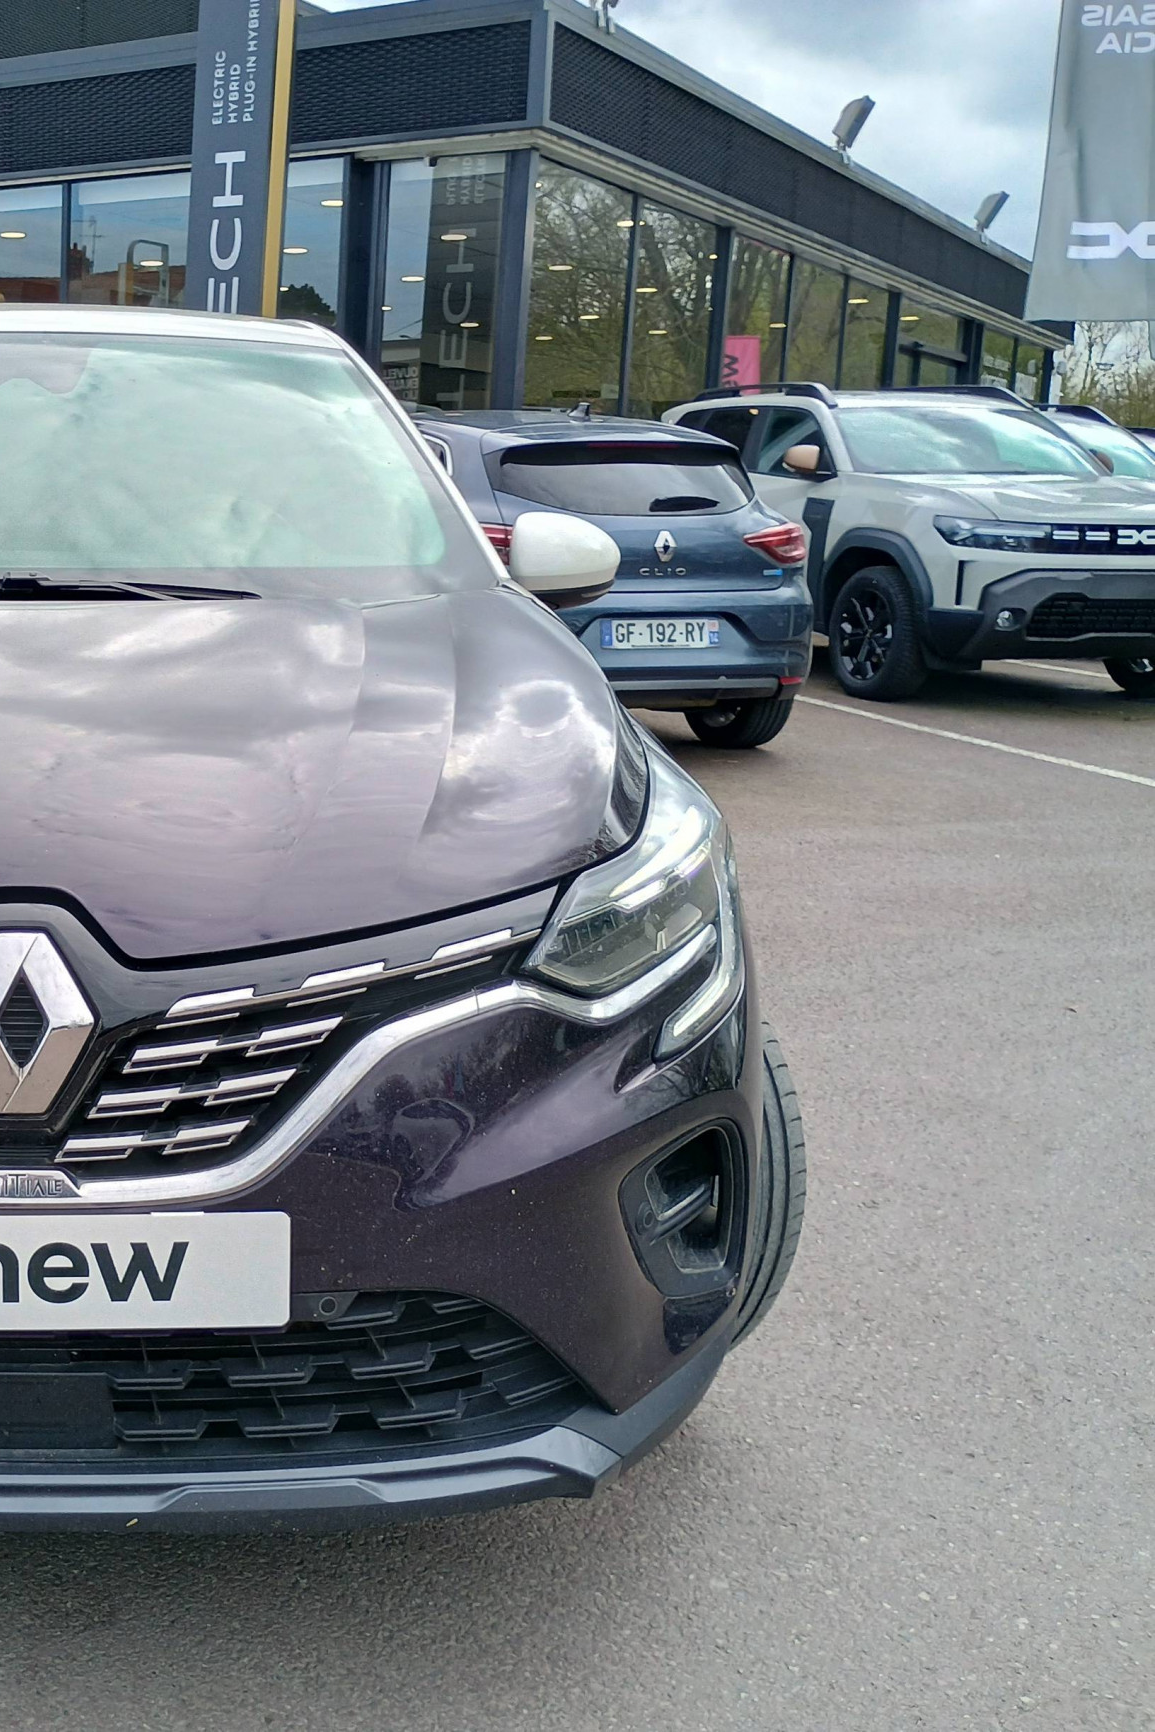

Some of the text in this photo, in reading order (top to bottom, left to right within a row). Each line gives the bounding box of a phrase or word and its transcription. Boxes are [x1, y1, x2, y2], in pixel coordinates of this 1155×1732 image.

[212, 50, 226, 125] ELECTRIC
[242, 0, 261, 122] PLUG-IN HYBRI
[227, 64, 241, 123] HYBRID
[639, 567, 687, 576] CLIO
[615, 622, 706, 643] GF-192-RY
